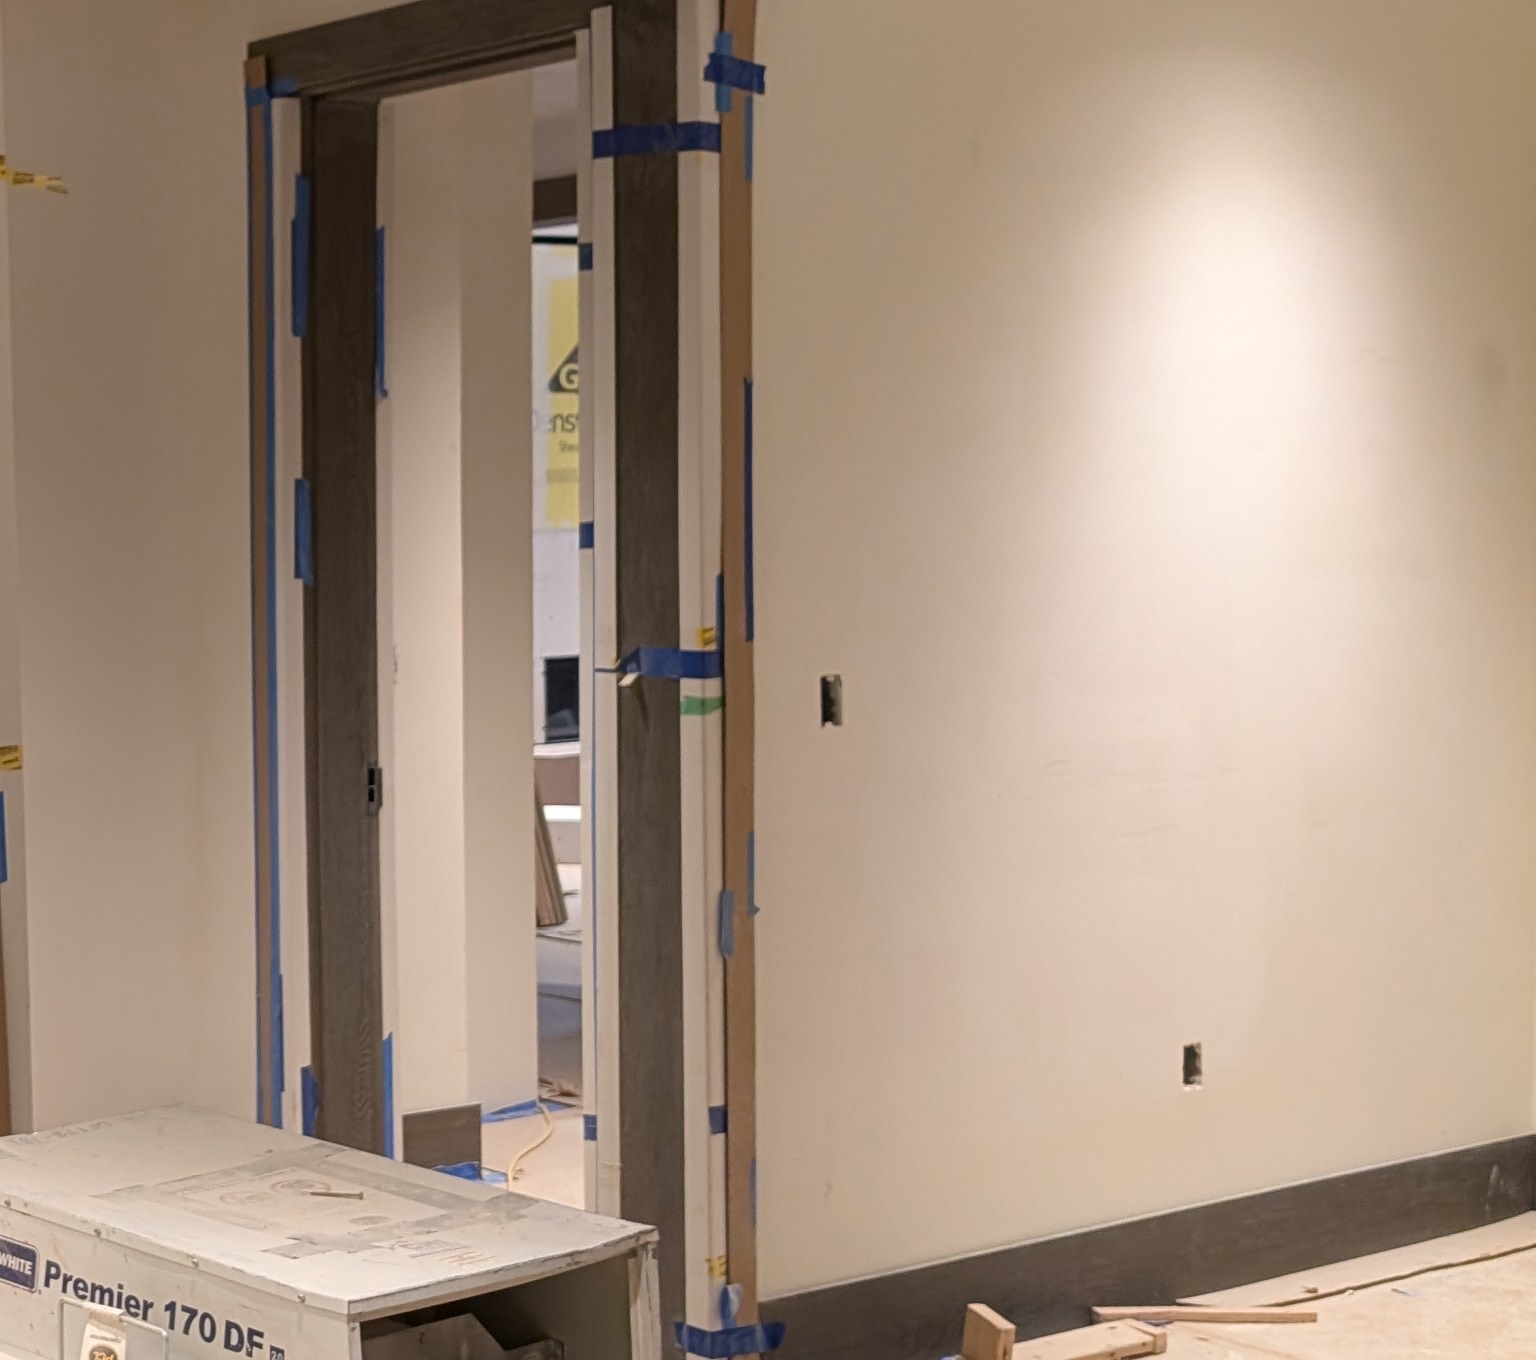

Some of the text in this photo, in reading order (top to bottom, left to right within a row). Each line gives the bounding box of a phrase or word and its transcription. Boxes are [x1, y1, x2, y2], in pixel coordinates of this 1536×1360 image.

[44, 1259, 154, 1321] Premier
[164, 1300, 217, 1343] 170
[224, 1319, 265, 1358] DF
